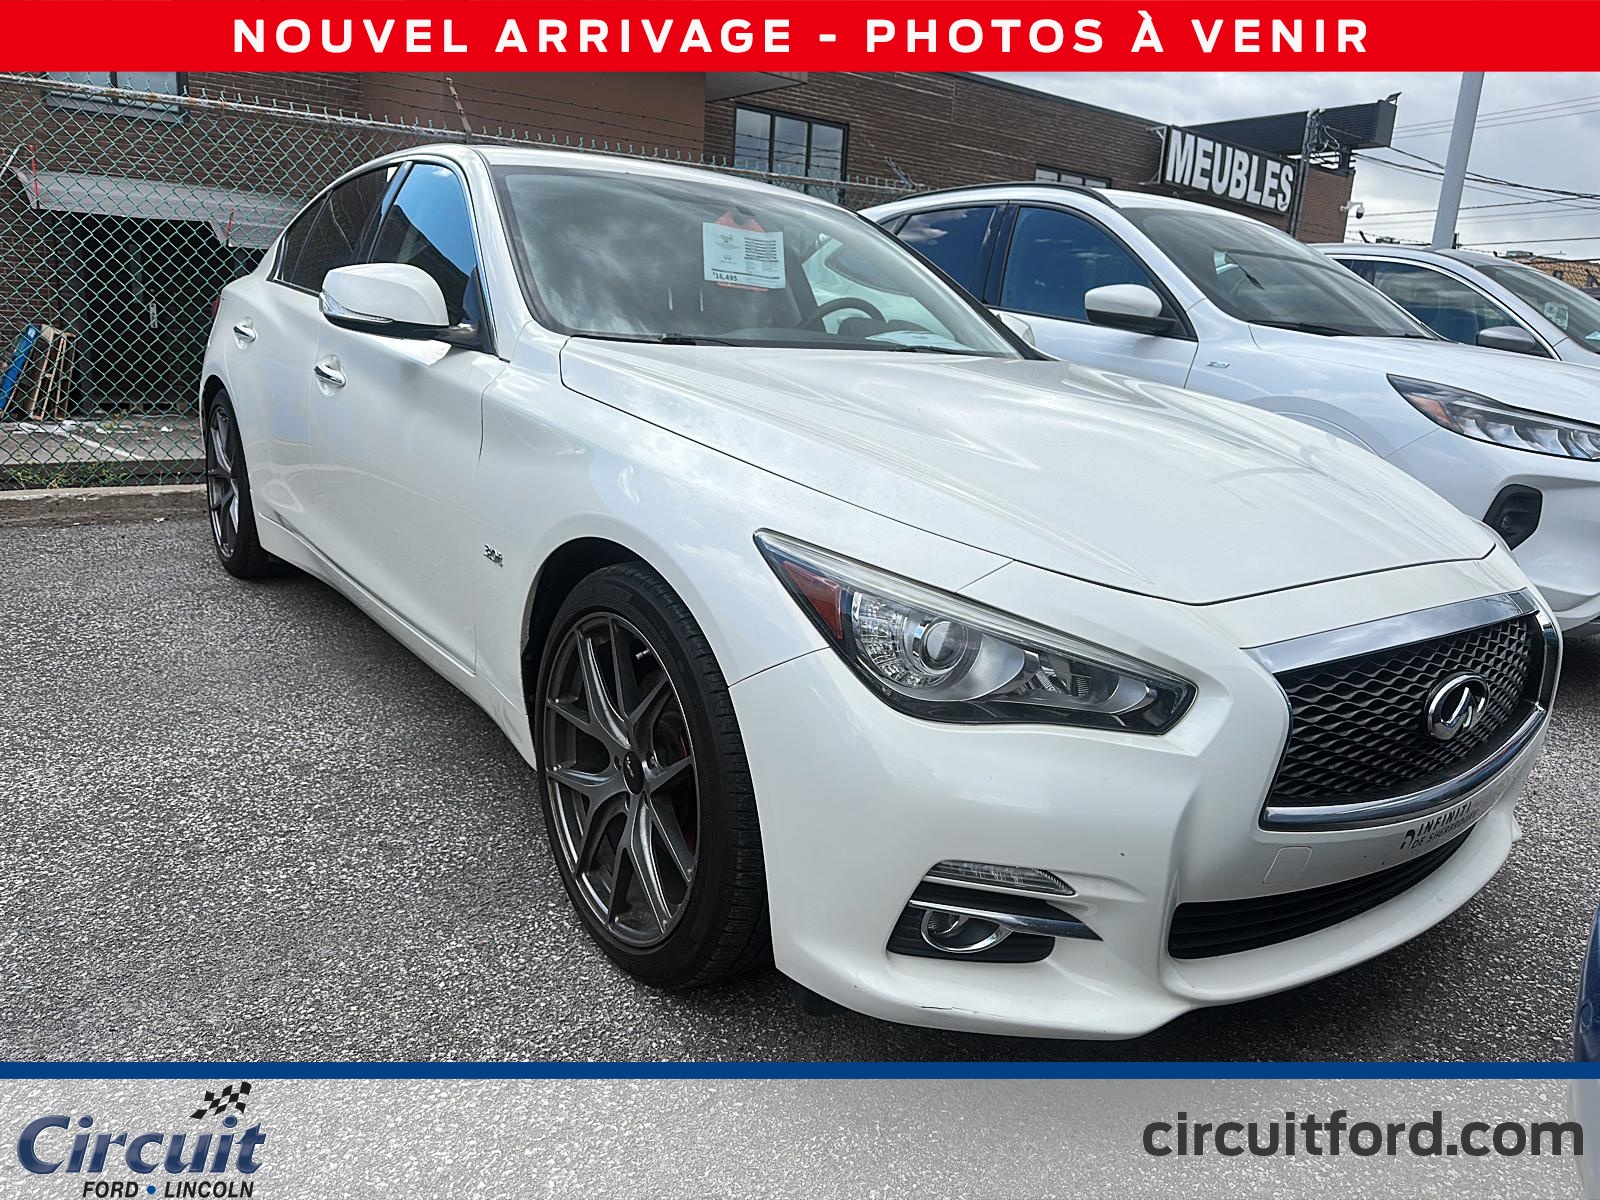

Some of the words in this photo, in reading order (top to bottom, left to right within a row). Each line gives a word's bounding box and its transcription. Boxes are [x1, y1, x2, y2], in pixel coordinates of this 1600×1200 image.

[1165, 128, 1294, 213] MEUBLES
[1417, 801, 1472, 836] INFINITI
[1411, 836, 1426, 849] DE
